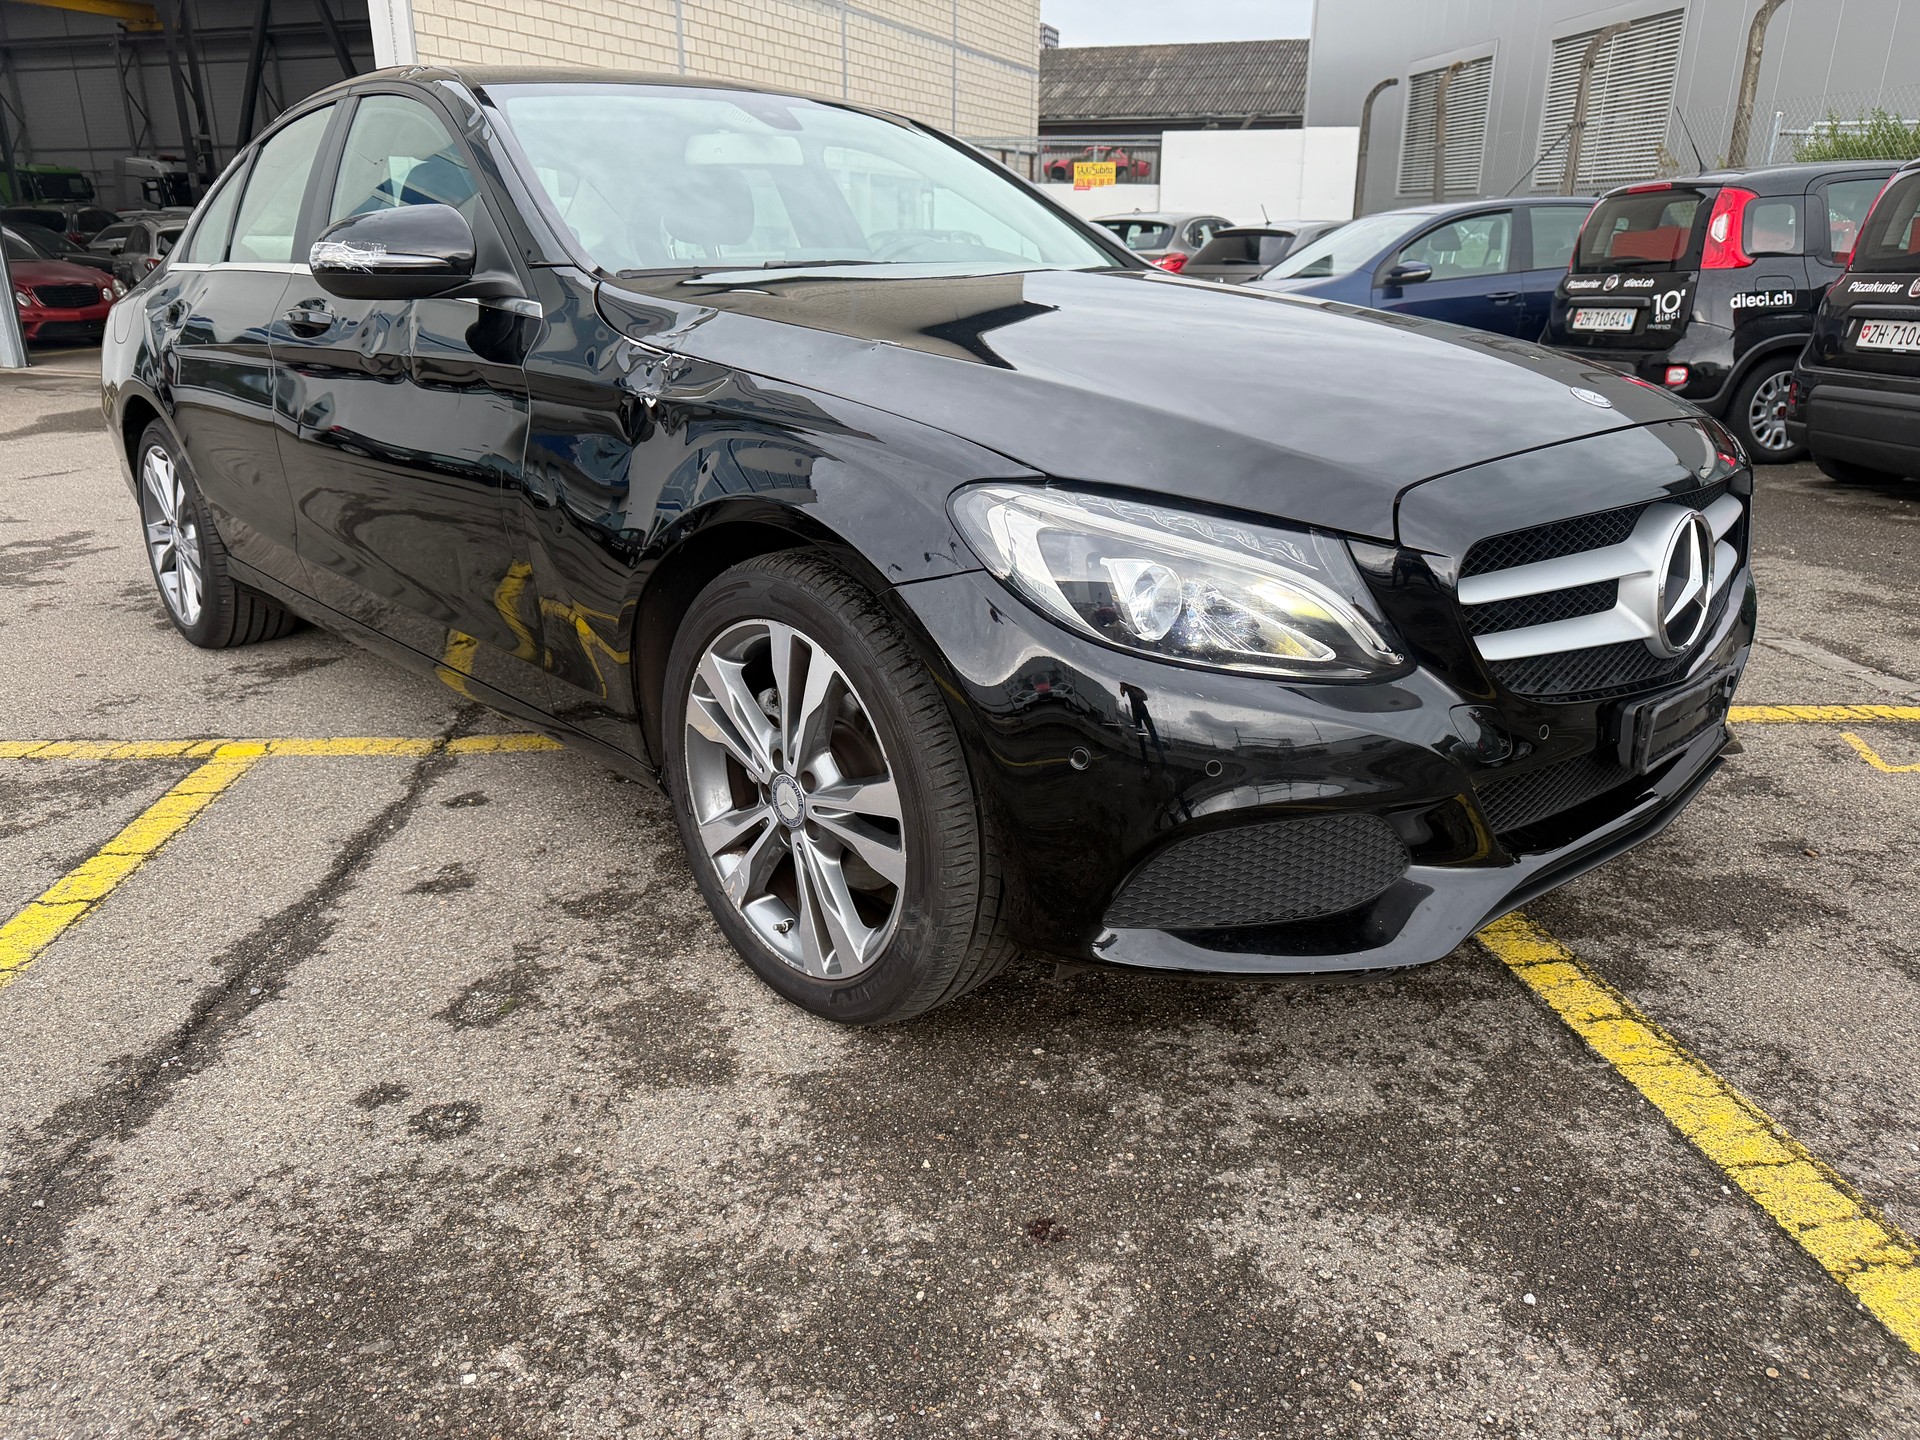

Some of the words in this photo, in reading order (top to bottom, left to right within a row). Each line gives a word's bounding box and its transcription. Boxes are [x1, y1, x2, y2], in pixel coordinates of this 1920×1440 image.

[1848, 281, 1904, 293] Pizzakurier
[1730, 290, 1793, 309] dieci.ch
[1655, 310, 1680, 323] dieci
